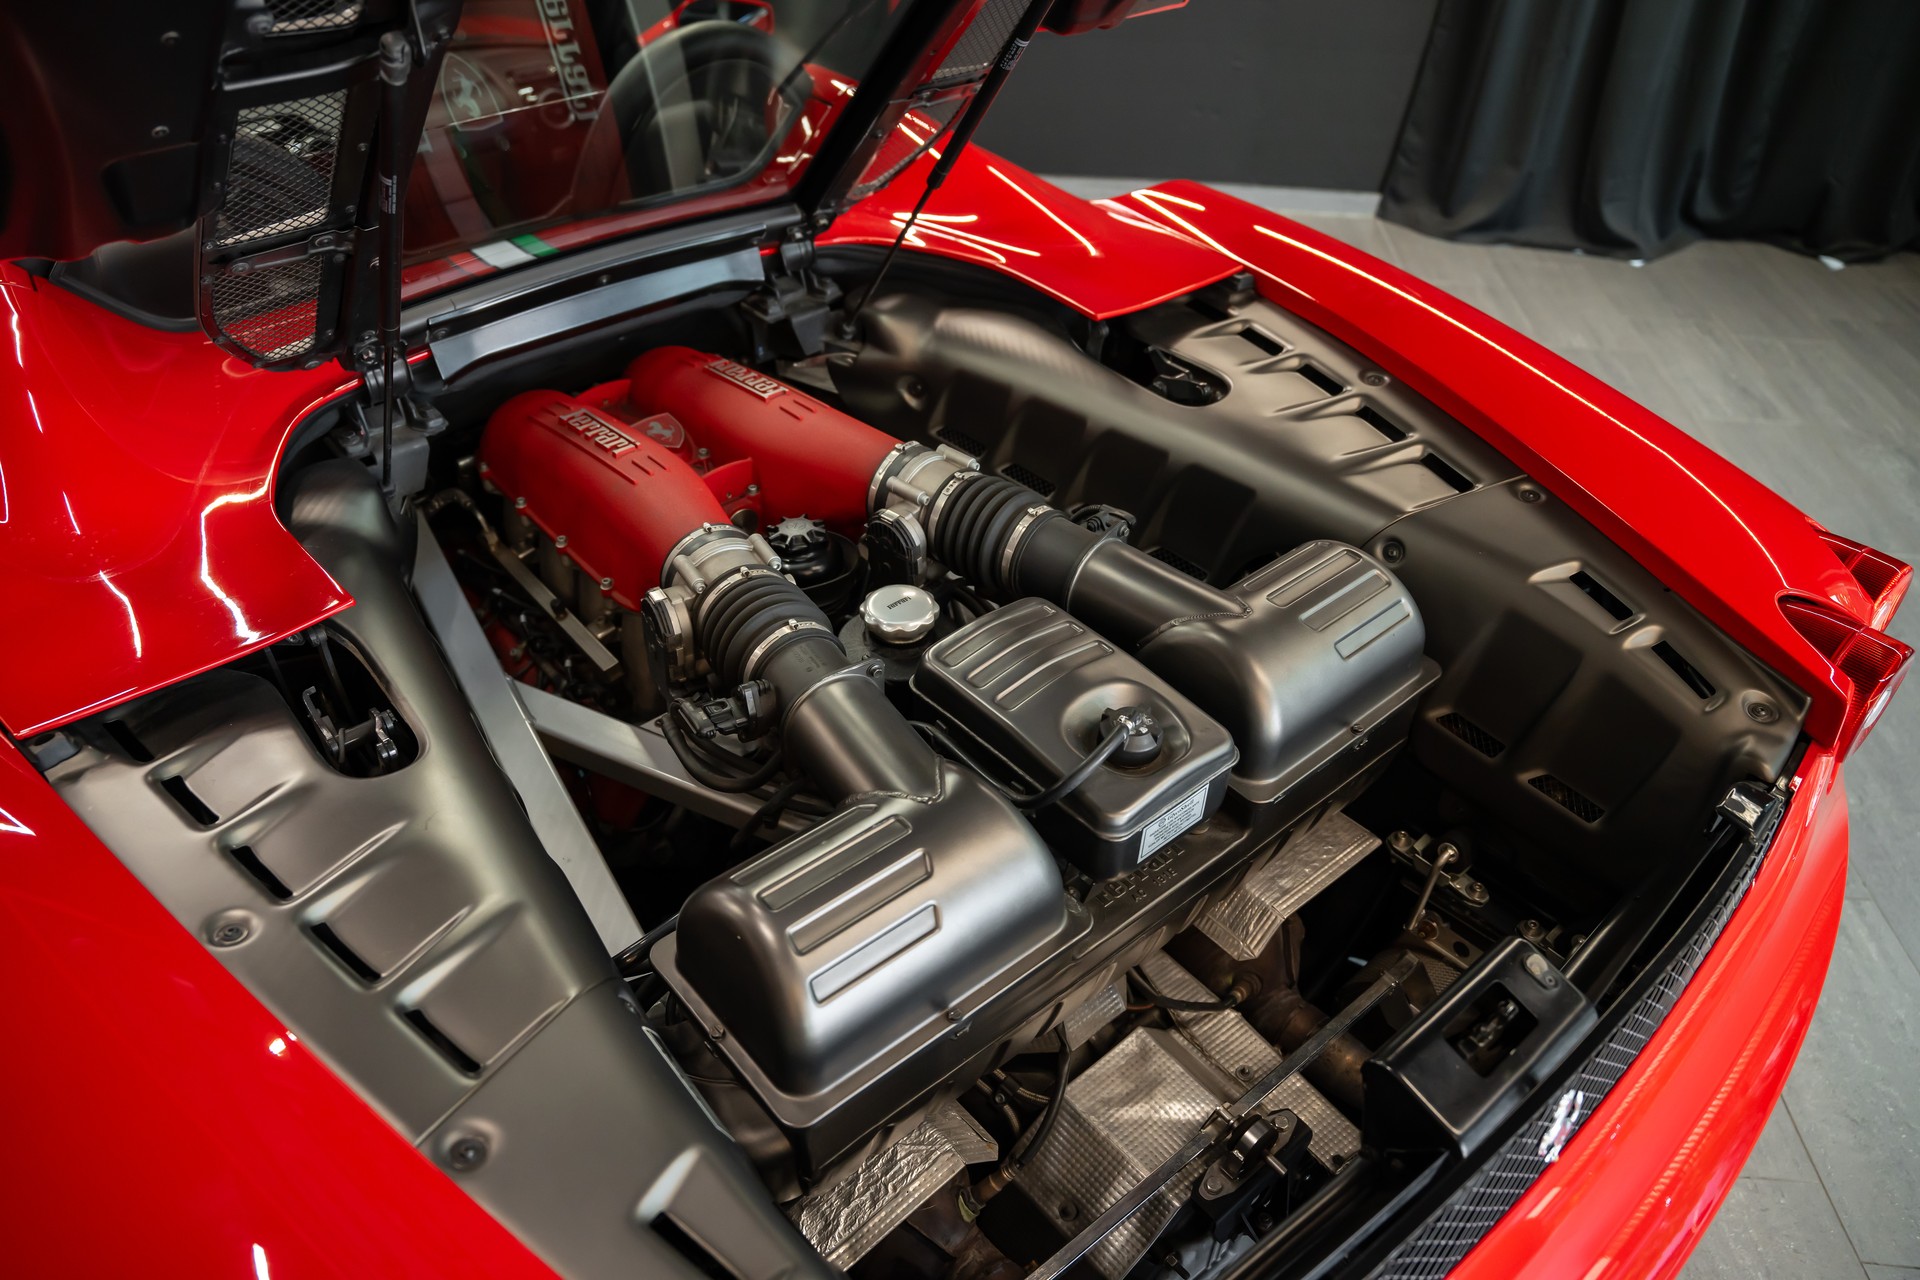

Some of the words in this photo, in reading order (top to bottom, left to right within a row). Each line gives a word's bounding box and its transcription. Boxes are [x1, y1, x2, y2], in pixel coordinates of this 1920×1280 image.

[704, 358, 790, 402] Ferrari
[558, 407, 641, 458] Ferrari
[886, 595, 912, 610] Ferrari
[1095, 842, 1186, 908] Ferrari
